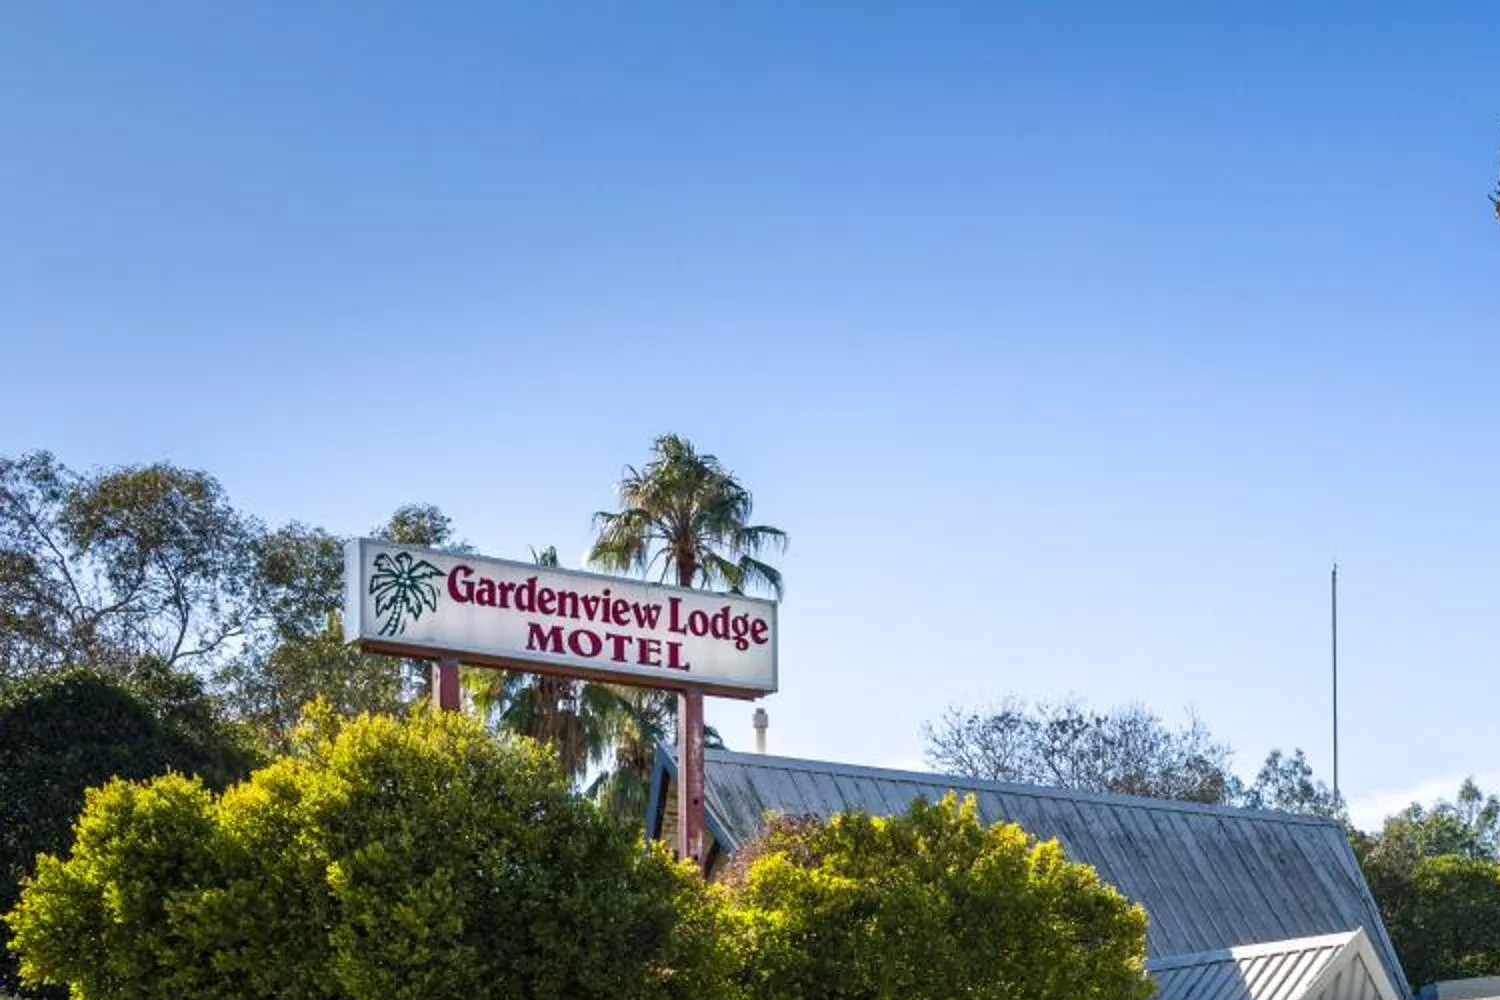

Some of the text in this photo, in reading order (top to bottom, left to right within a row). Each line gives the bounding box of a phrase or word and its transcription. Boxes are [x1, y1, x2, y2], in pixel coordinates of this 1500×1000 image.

[447, 564, 769, 651] Gardenview Lodge
[527, 622, 690, 672] MOTEL
